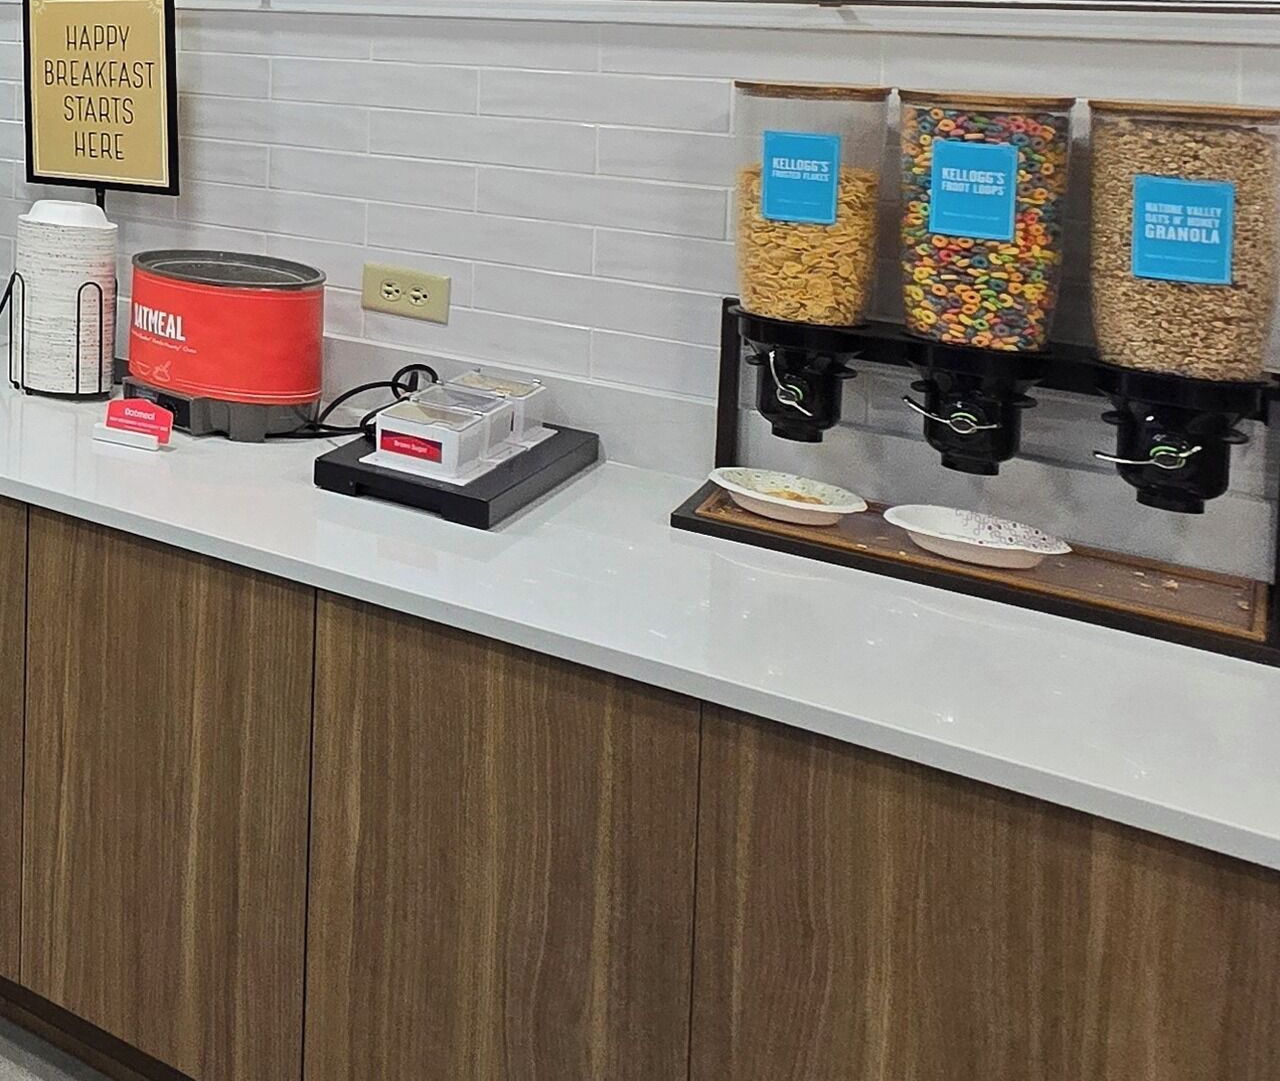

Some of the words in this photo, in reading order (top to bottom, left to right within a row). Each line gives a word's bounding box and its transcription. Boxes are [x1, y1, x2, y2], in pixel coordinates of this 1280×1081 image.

[66, 25, 130, 51] HAPPY
[44, 59, 155, 89] BREAKFAST
[63, 95, 134, 124] STARTS
[74, 131, 125, 160] HERE
[772, 157, 831, 173] KELLOGG'S
[941, 167, 1007, 185] KELLOGG'S
[973, 183, 1006, 196] LOOPS
[1144, 213, 1170, 224] OATS
[1186, 206, 1222, 218] VALLEY
[1144, 224, 1221, 245] GRANOLA
[124, 407, 156, 421] Oatmeal
